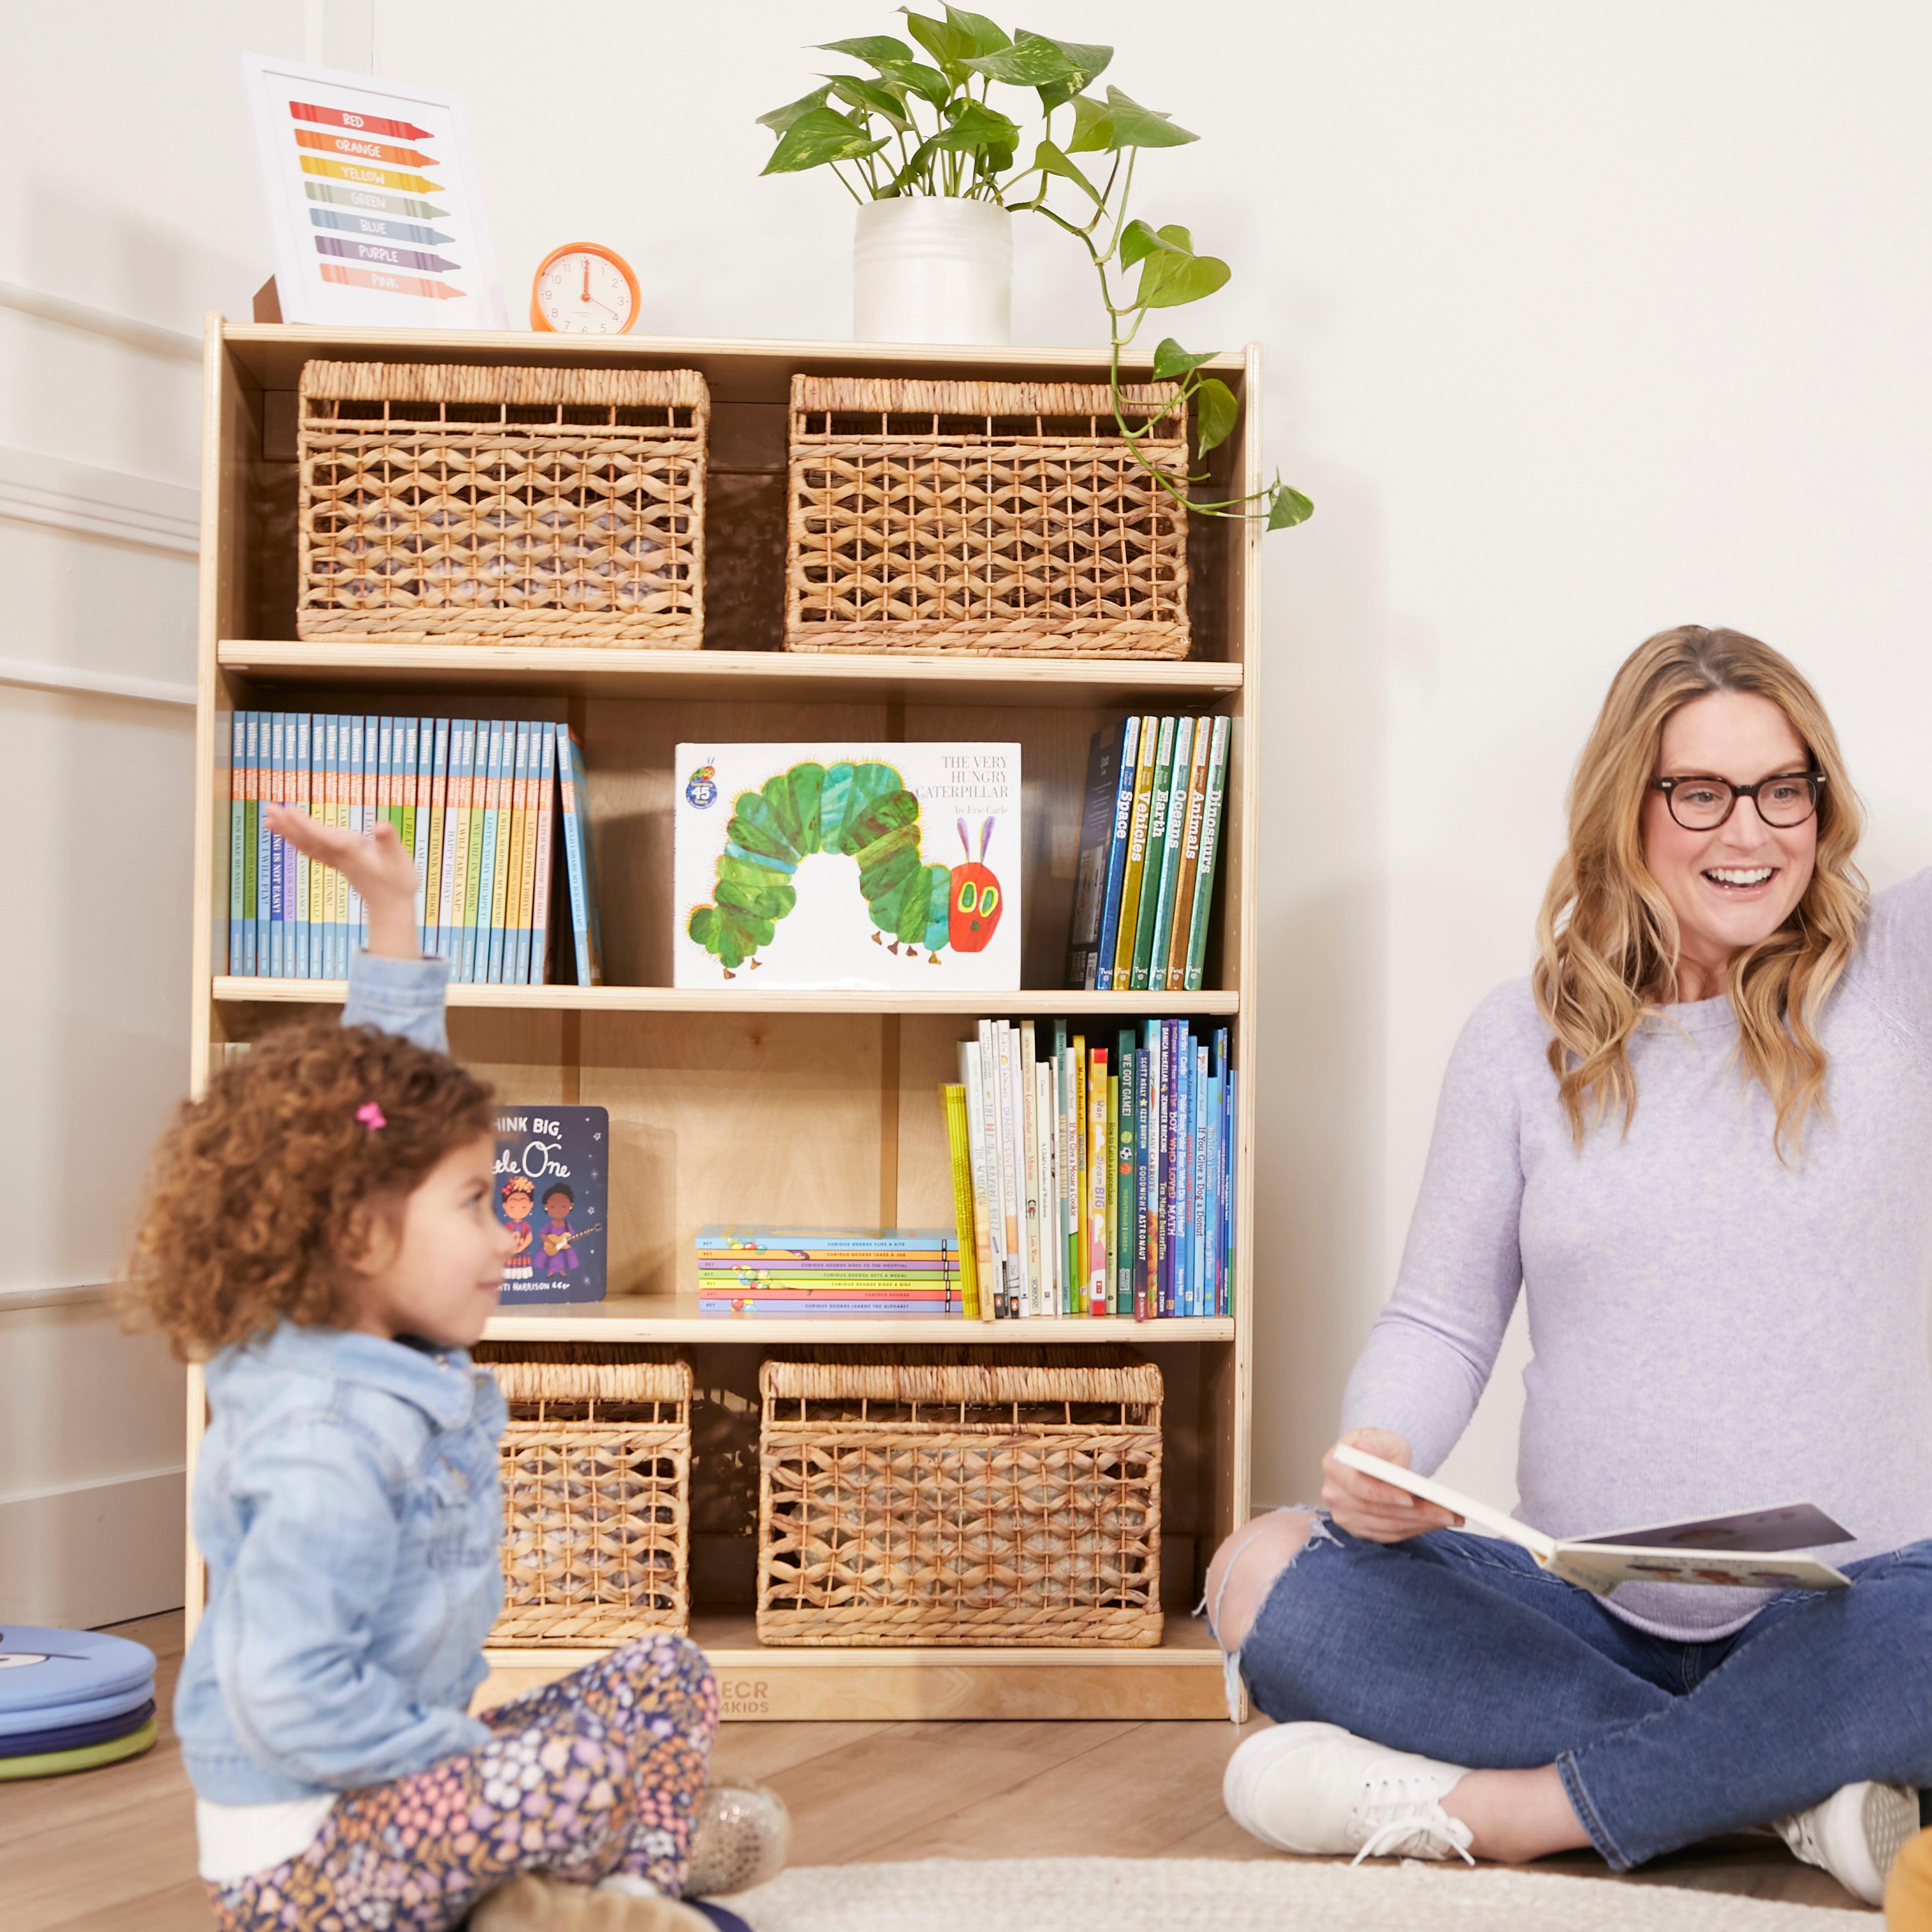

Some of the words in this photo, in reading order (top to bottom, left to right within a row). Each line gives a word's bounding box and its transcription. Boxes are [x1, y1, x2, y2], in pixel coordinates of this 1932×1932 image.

[342, 113, 364, 128] RED
[335, 140, 382, 158] ORANGE
[341, 166, 385, 185] YELLOW
[351, 192, 386, 209] GREEN
[359, 219, 387, 235] BLUE
[359, 245, 399, 263] PURPLE
[371, 274, 399, 289] PINK
[551, 275, 562, 284] 10
[564, 264, 571, 273] 11
[601, 267, 605, 276] 1
[545, 290, 552, 300] 9
[612, 279, 618, 288] 2
[552, 308, 558, 318] 8
[618, 297, 624, 306] 3
[565, 321, 570, 330] 7
[600, 324, 607, 333] 5
[612, 313, 619, 322] 4
[235, 723, 245, 758] Willems
[247, 723, 258, 757] Willems
[260, 723, 271, 758] Willems
[273, 725, 283, 759] Willems
[286, 725, 296, 760] Willems
[298, 724, 309, 759] Willems
[313, 726, 324, 761] Willems
[327, 725, 337, 760] Willems
[340, 726, 350, 761] Willems
[352, 728, 362, 763] Willems
[366, 728, 377, 762] Willems
[380, 729, 390, 764] Willems
[394, 729, 404, 764] Willems
[407, 729, 417, 764] Willems
[421, 730, 432, 765] Willems
[436, 730, 447, 765] Willems
[452, 730, 463, 765] Willems
[462, 731, 473, 766] Willems
[477, 731, 488, 766] Willems
[489, 732, 500, 767] Willems
[503, 732, 513, 767] Willems
[516, 733, 527, 768] Willems
[529, 733, 541, 767] Willems
[542, 733, 554, 768] Willems
[558, 736, 568, 770] Willems
[942, 756, 970, 768] THE
[974, 756, 1009, 768] VERY
[952, 771, 1009, 783] HUNGRY
[691, 786, 710, 800] 45
[915, 786, 1008, 797] CATERPILLAR
[955, 805, 965, 815] by
[967, 805, 983, 814] Eric
[986, 805, 1009, 814] Carle
[1116, 790, 1133, 839] Space
[1152, 789, 1169, 838] Earth
[1170, 790, 1187, 849] Oceans
[1131, 791, 1151, 862] Vehicles
[1185, 789, 1205, 859] Animals
[1201, 789, 1222, 874] Dinosaurs
[273, 853, 282, 862] IS
[431, 838, 440, 868] THANK
[456, 855, 465, 878] TAKE
[526, 848, 533, 859] GO
[273, 865, 281, 883] NOT
[430, 870, 438, 889] YOU
[272, 886, 281, 913] EASY!
[428, 891, 437, 918] BOOK
[522, 889, 530, 917] DRIVE!
[1122, 1054, 1132, 1067] WE
[1122, 1069, 1132, 1087] GOT
[1122, 1089, 1131, 1116] GAME!
[533, 1118, 563, 1140] BIG,
[1003, 1107, 1012, 1144] DRAGONS
[522, 1141, 571, 1178] One
[1168, 1137, 1177, 1163] WHO
[1096, 1156, 1104, 1185] Dream
[1094, 1187, 1105, 1208] BIG
[1107, 1169, 1116, 1205] Leprechaun
[1178, 1190, 1185, 1200] Do
[1195, 1183, 1205, 1200] Dog
[1158, 1197, 1166, 1219] Magic
[1196, 1210, 1204, 1236] Donut
[512, 1281, 550, 1291] HARRISON
[722, 1681, 769, 1699] ECR
[721, 1702, 769, 1713] 4KIDS
